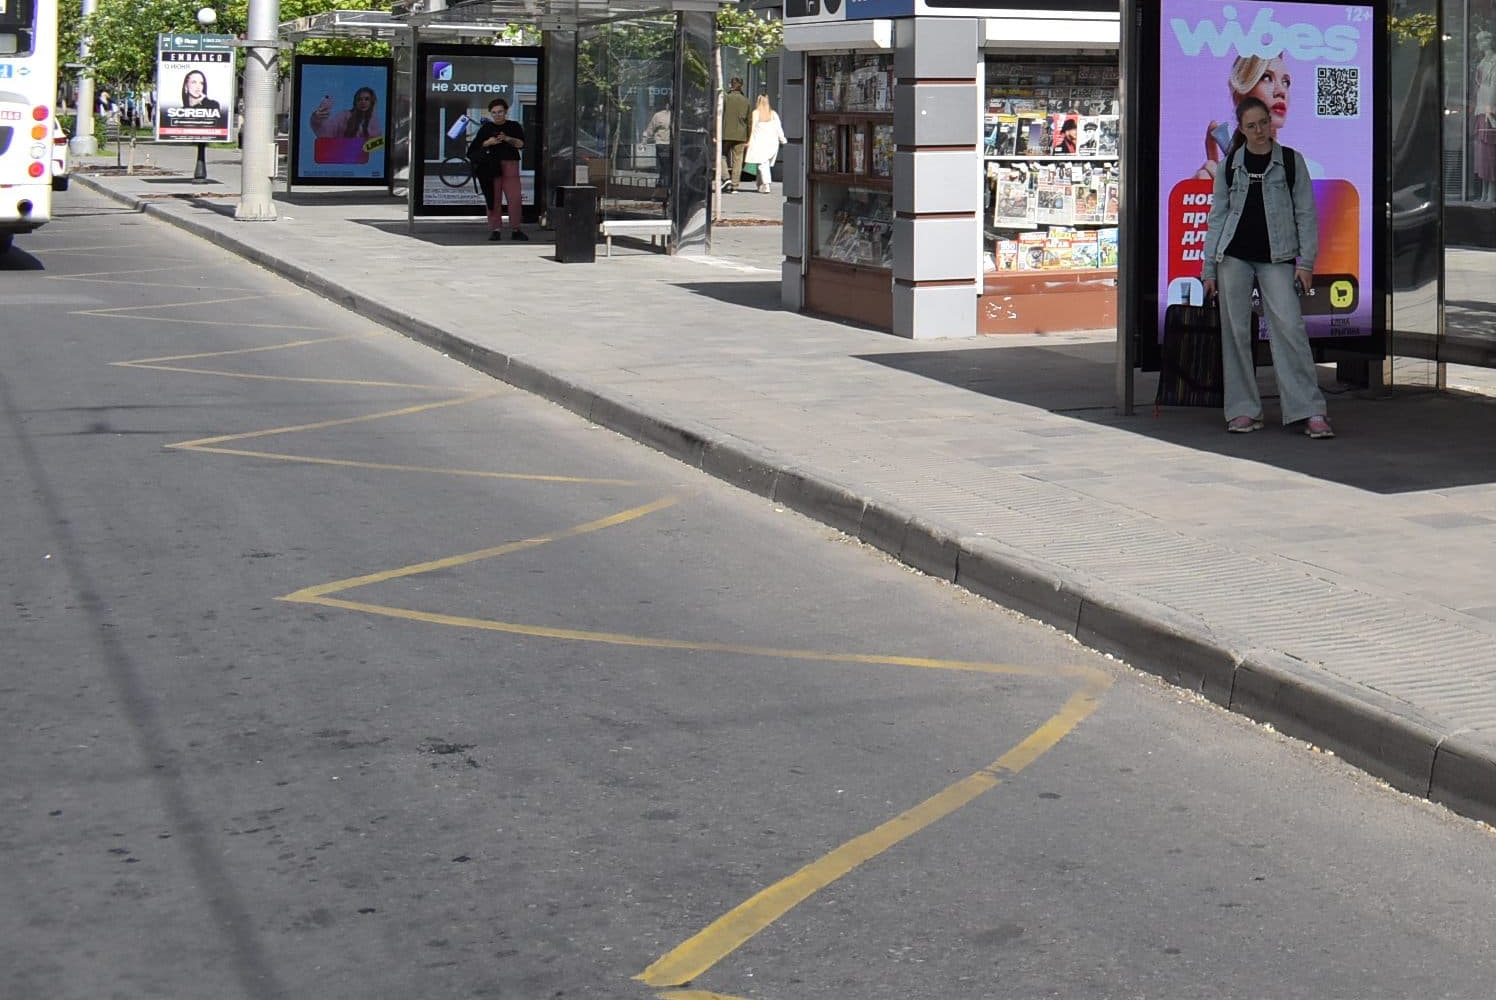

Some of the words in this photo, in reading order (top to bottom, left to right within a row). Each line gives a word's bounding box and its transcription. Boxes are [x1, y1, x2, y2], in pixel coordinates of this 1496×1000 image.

[1345, 6, 1371, 22] 12+
[452, 83, 509, 94] хватает
[167, 107, 221, 118] SCIRENA
